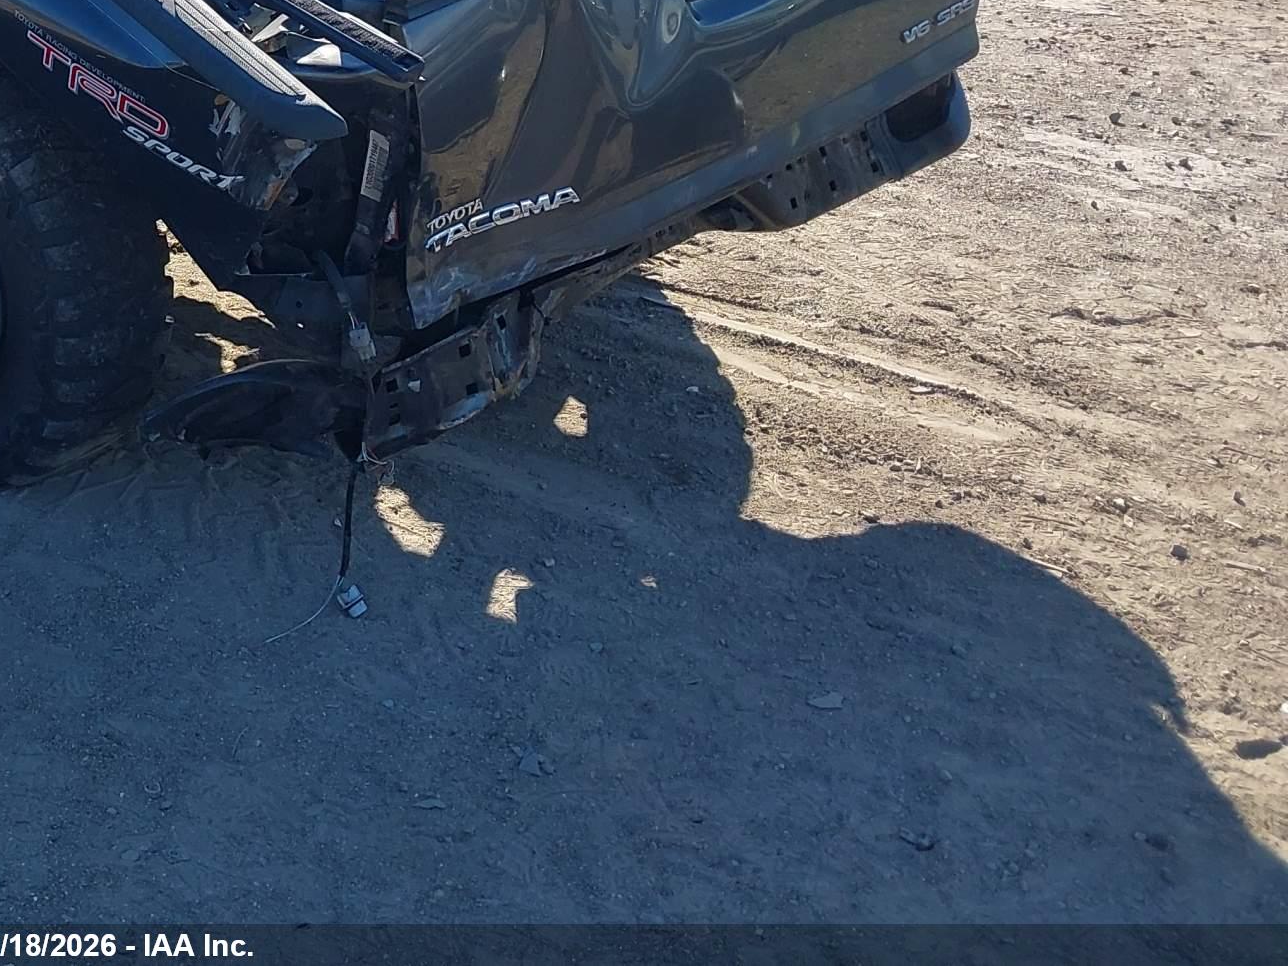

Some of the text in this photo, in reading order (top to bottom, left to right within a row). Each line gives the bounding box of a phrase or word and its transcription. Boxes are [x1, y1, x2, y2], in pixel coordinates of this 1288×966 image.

[13, 9, 145, 103] TOYOTA RACING DEVELOPMENT
[903, 20, 930, 44] V6
[26, 30, 170, 140] TRD
[122, 125, 245, 190] SPORT
[424, 185, 581, 253] TACOMA
[426, 197, 484, 235] TOYOTA
